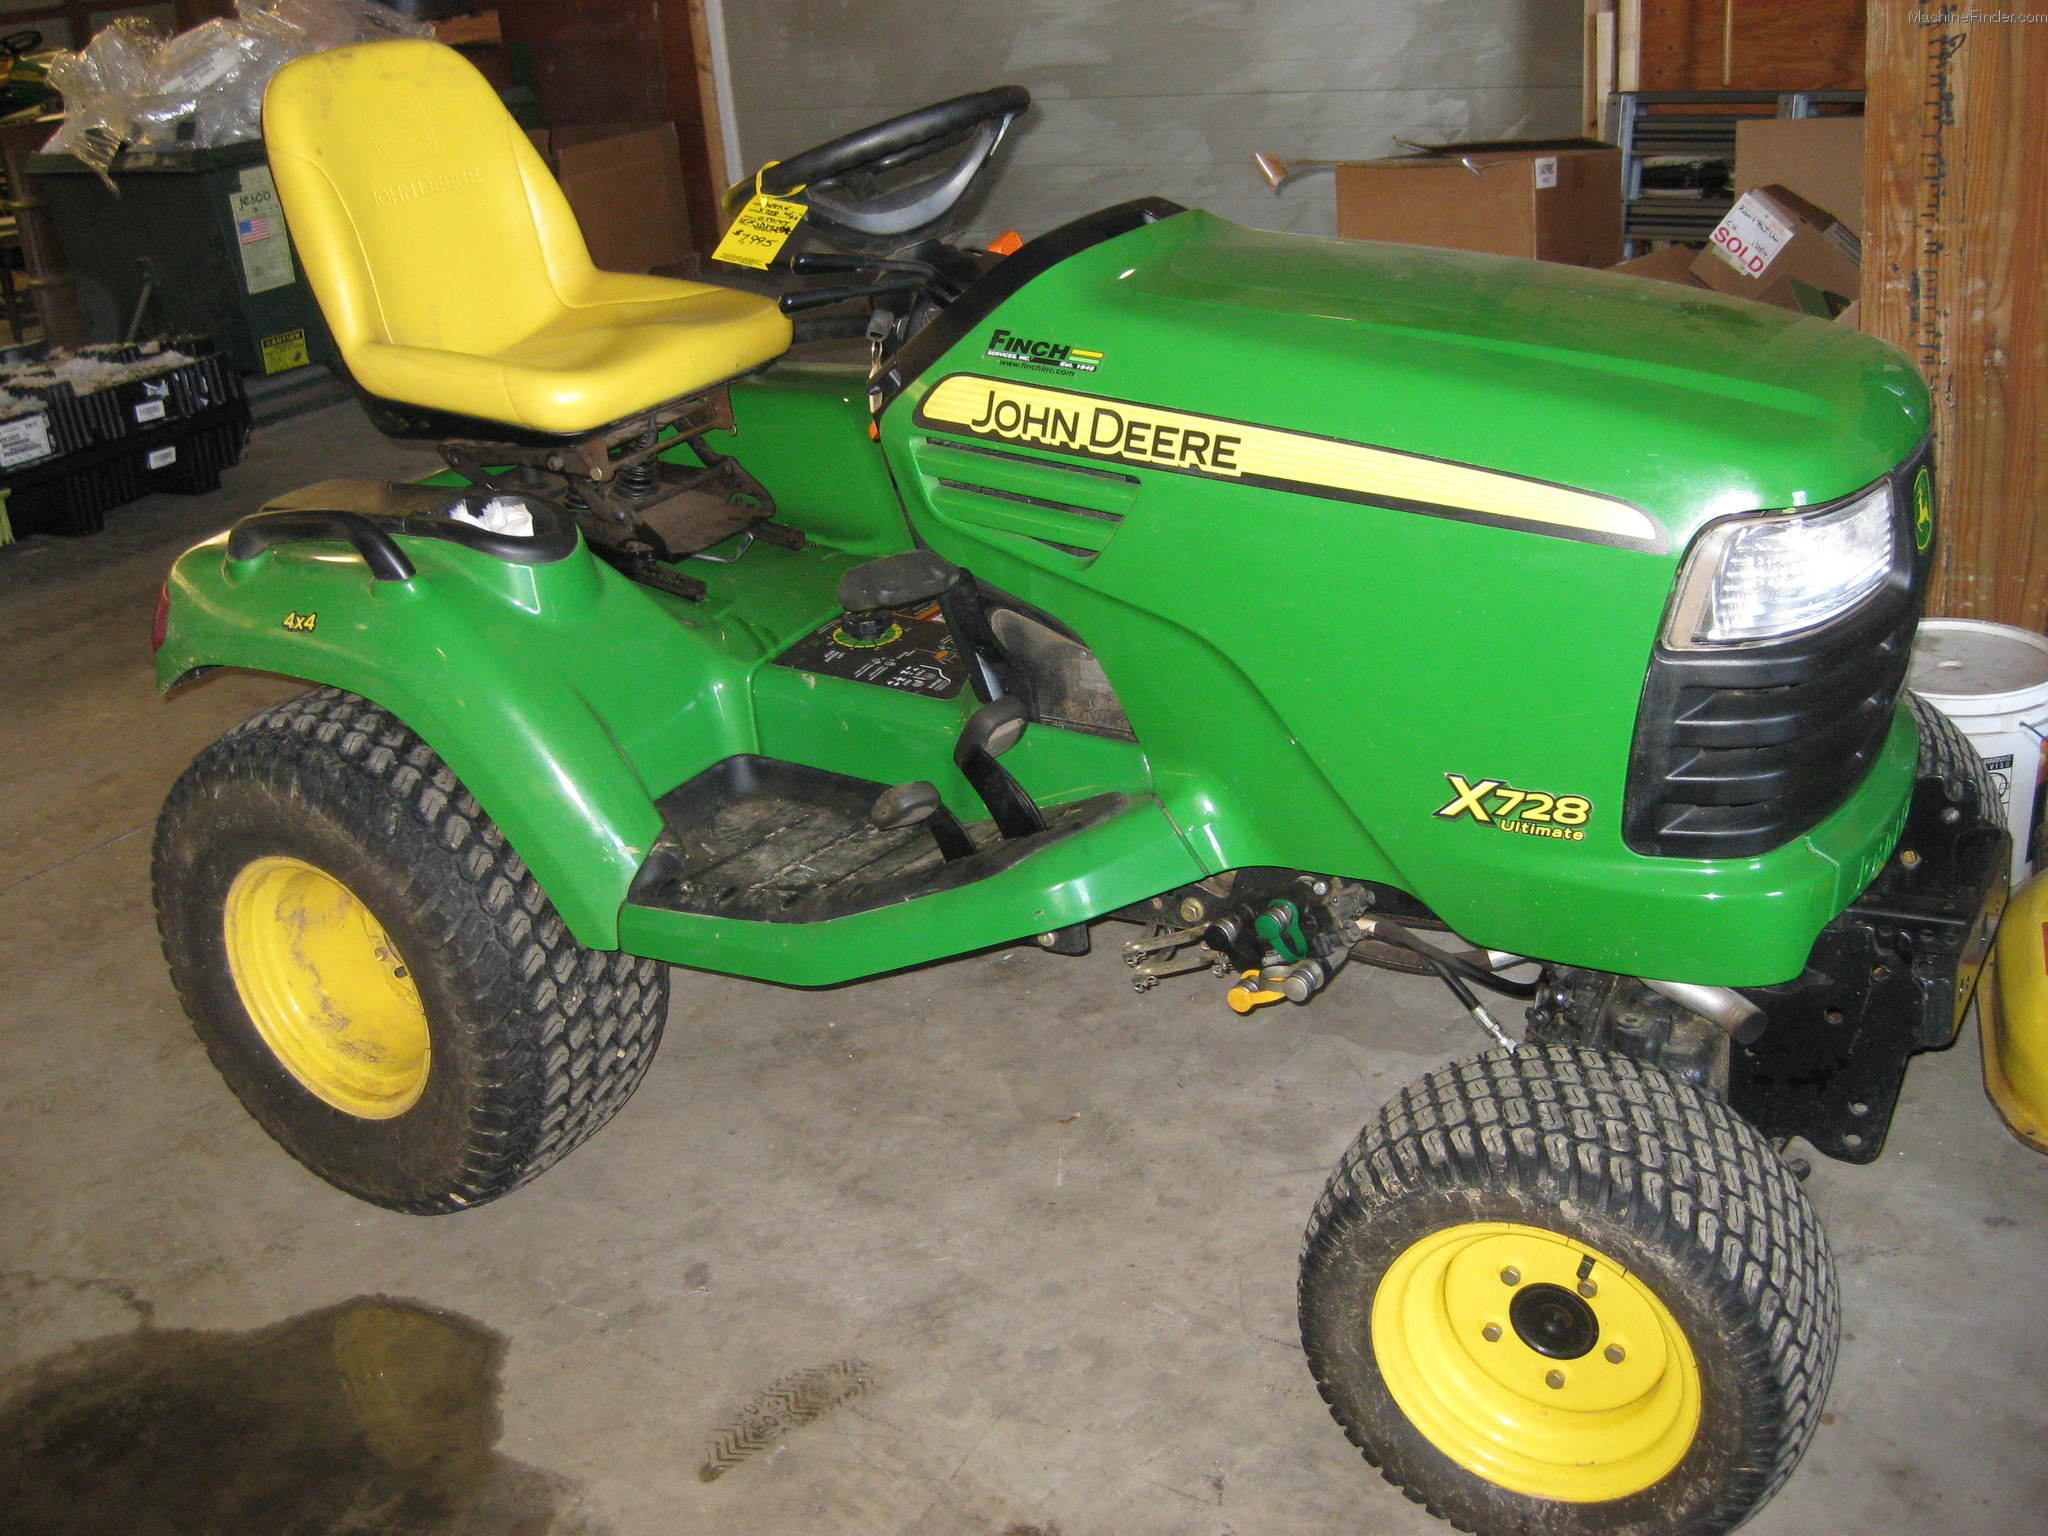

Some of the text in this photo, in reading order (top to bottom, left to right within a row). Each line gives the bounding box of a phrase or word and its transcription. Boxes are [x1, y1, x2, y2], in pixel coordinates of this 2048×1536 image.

[1714, 226, 1764, 273] SOLD
[988, 329, 1071, 360] FINCH
[971, 390, 1242, 470] JOHN DEERE
[1432, 772, 1594, 825] X728
[1500, 819, 1585, 841] Ultimate
